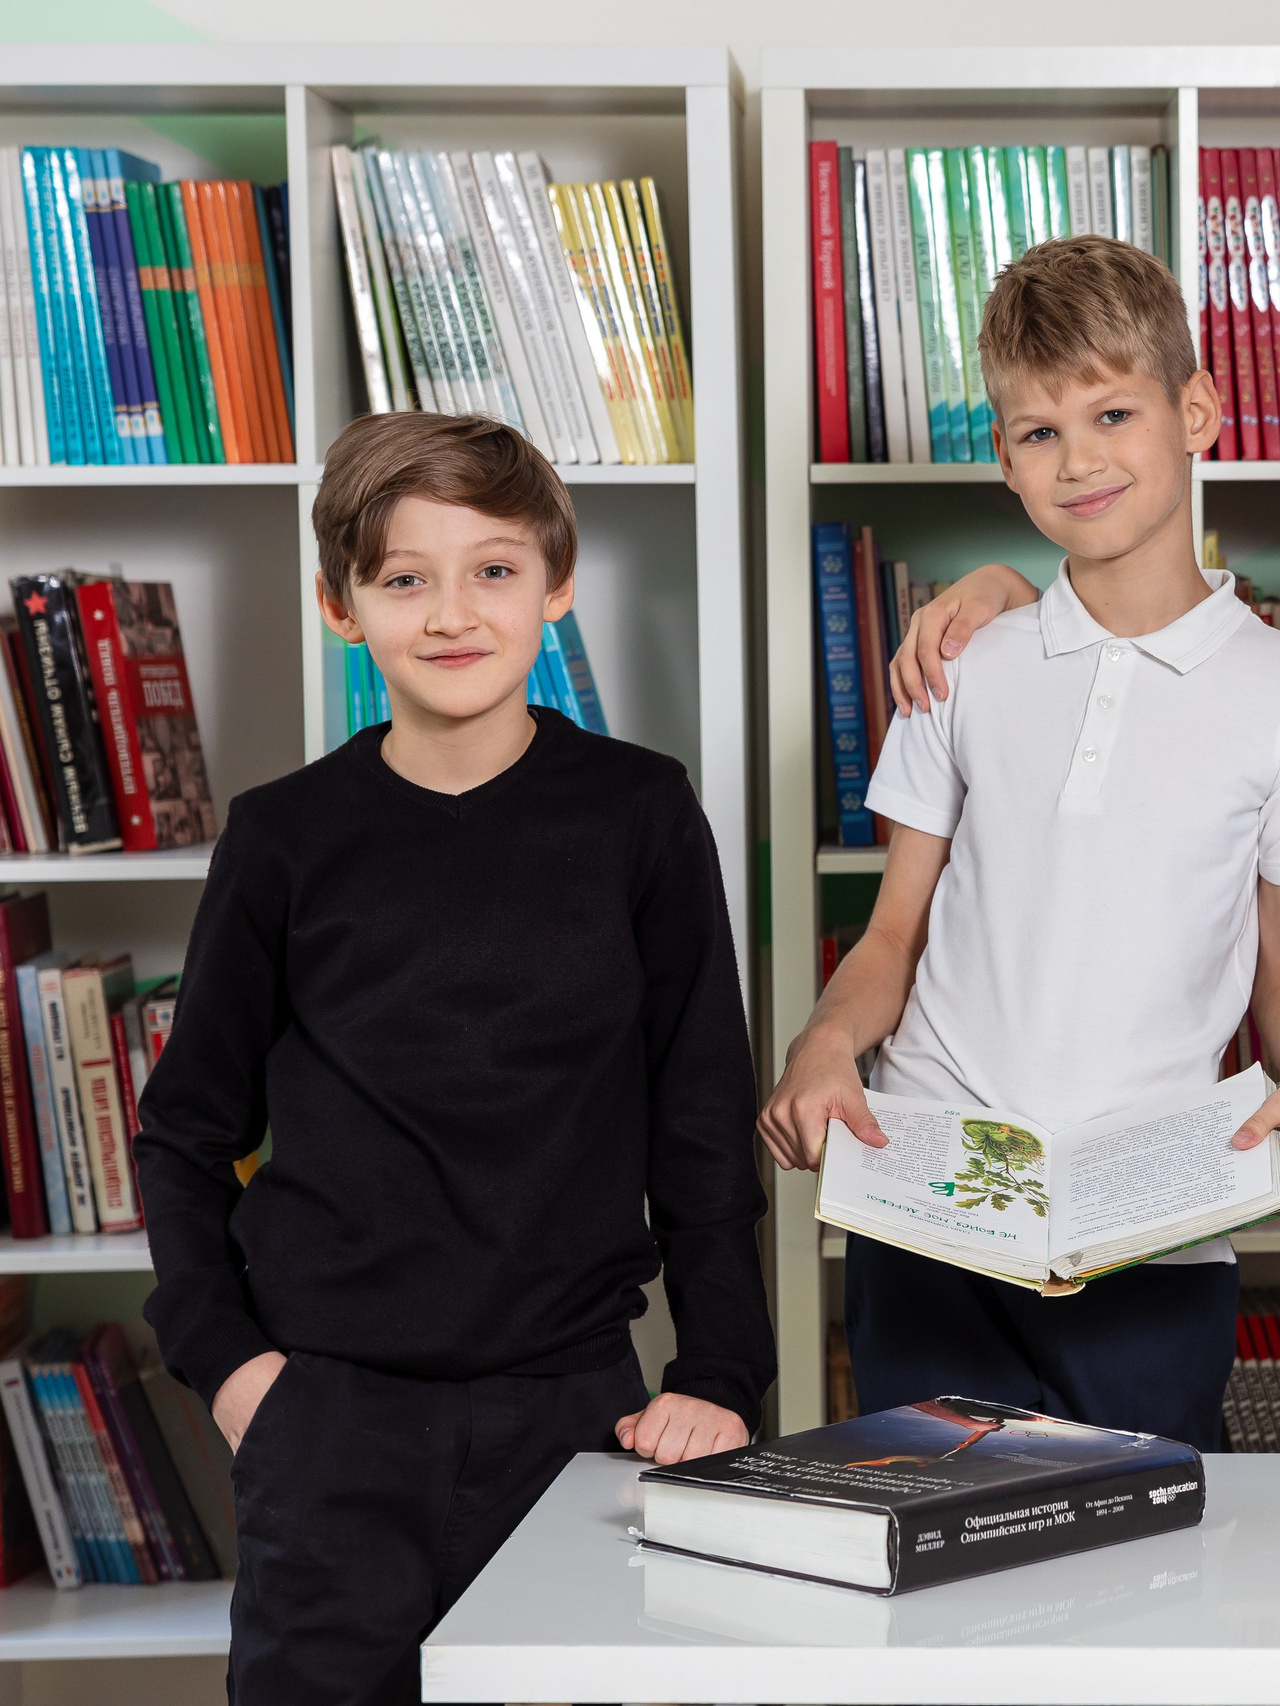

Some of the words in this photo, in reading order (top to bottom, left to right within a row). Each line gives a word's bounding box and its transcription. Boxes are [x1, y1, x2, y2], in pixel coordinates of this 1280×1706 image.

[866, 1193, 920, 1214] ДЕРЕВО!
[998, 1231, 1017, 1240] НЕ
[1149, 1488, 1167, 1499] sochi
[1166, 1481, 1198, 1496] education
[965, 1506, 1030, 1530] Официальная
[1031, 1500, 1069, 1518] история
[1096, 1508, 1107, 1517] 1894
[1113, 1505, 1124, 1514] 2008
[960, 1521, 1027, 1544] Олимпийских
[1028, 1518, 1045, 1533] игр
[1045, 1517, 1053, 1527] и
[1054, 1511, 1075, 1526] МОК
[917, 1530, 942, 1543] ДЭВИД
[915, 1540, 946, 1553] МИЛЛЕР
